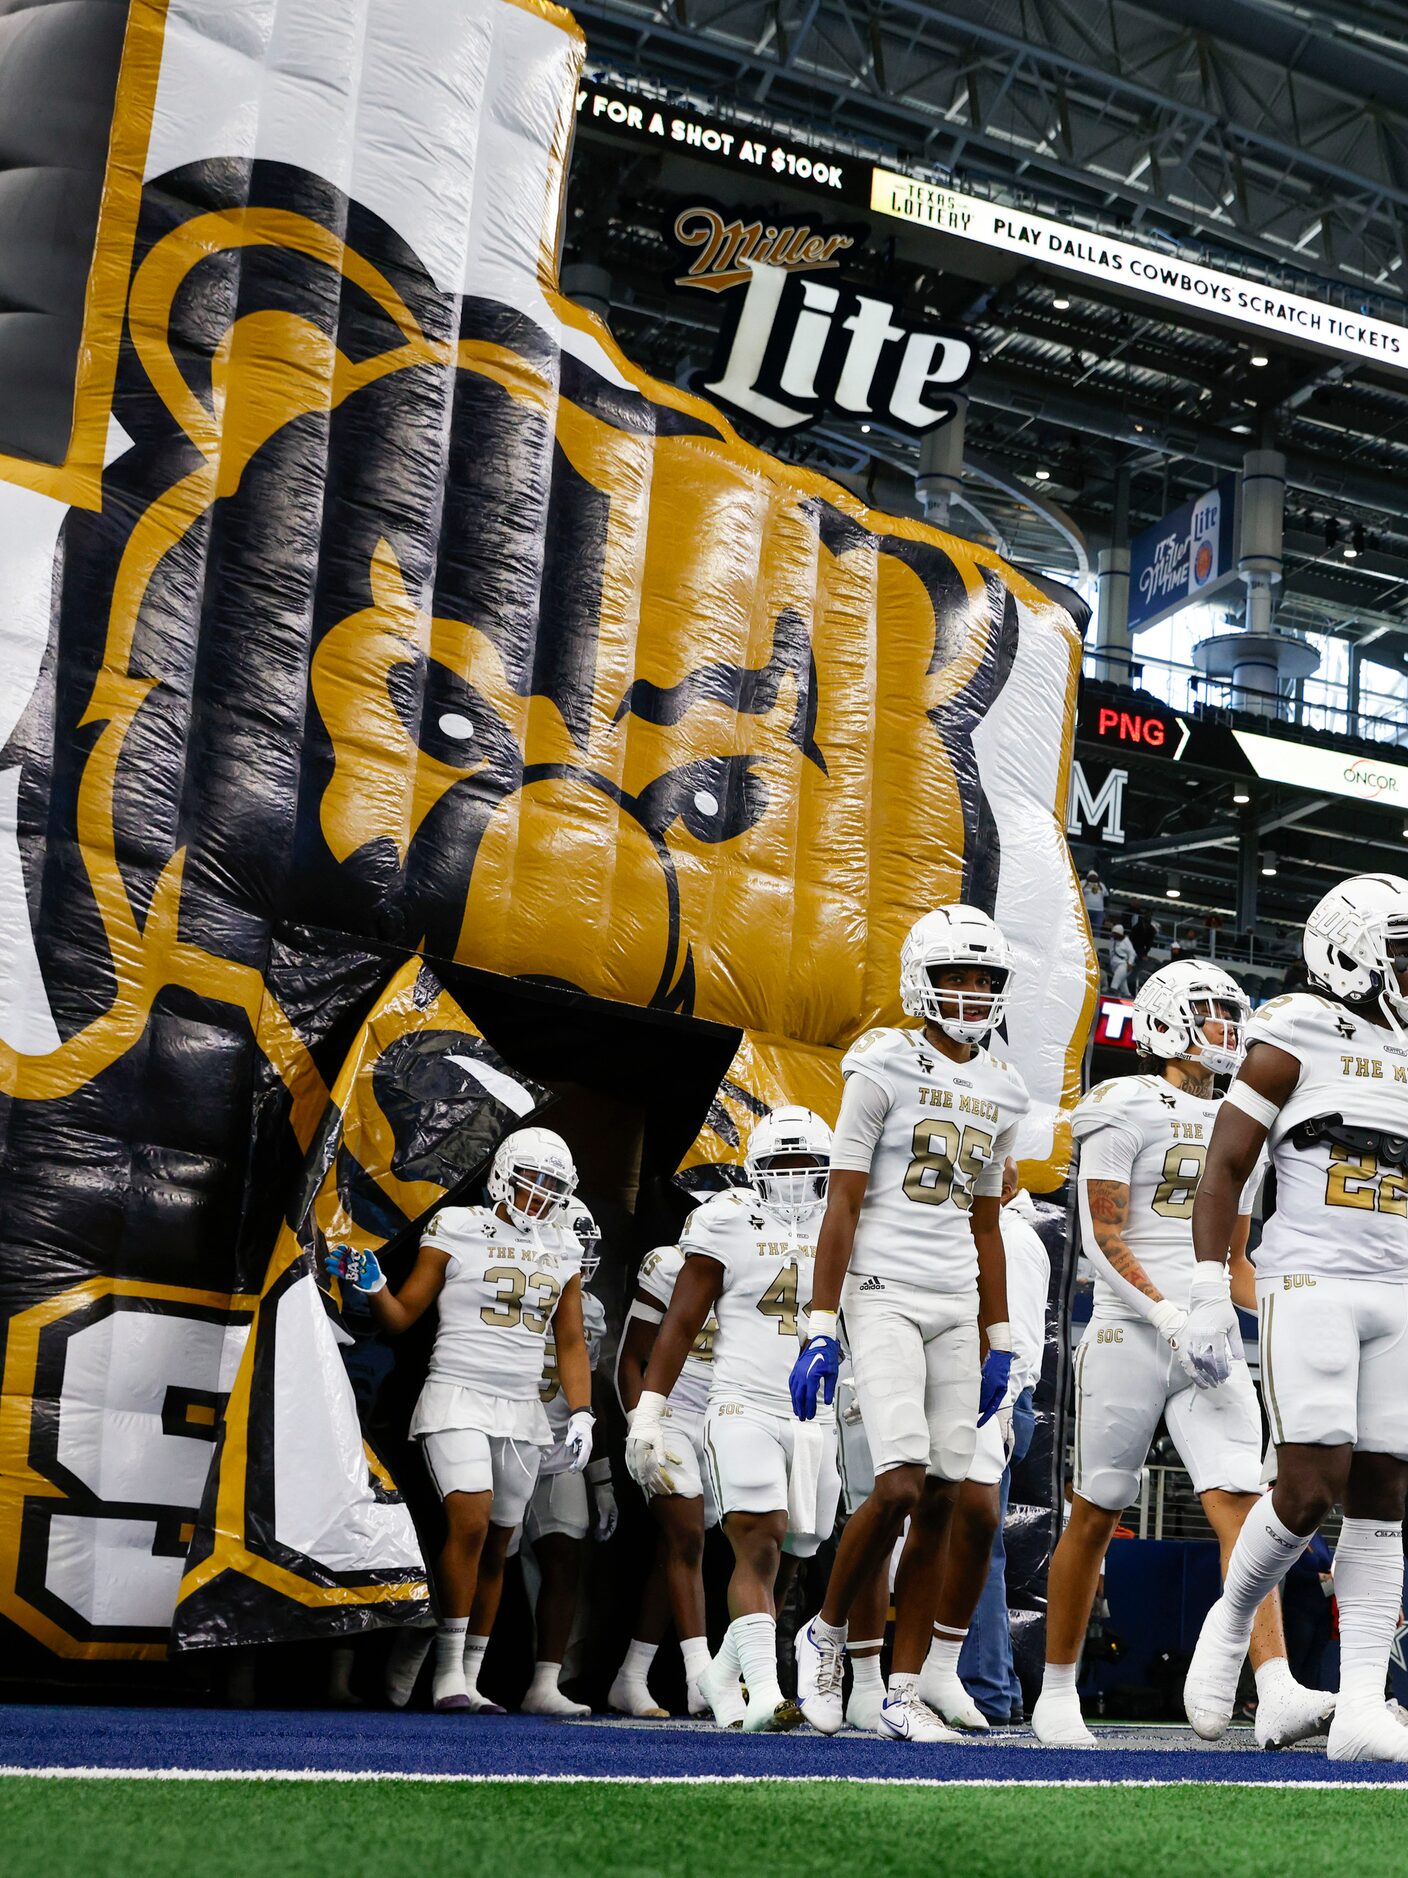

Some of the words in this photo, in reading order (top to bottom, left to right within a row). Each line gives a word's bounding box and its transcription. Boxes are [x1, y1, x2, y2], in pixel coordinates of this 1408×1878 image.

[593, 95, 643, 129] FOR
[649, 113, 664, 136] A
[671, 119, 734, 155] SHOT
[739, 140, 767, 165] AT
[771, 147, 843, 189] $100K
[892, 191, 971, 231] LOTTERY
[908, 184, 955, 209] TEXAS
[674, 206, 854, 280] Miller
[994, 218, 1041, 245] PLAY
[1049, 235, 1122, 269] DALLAS
[1130, 261, 1231, 302] COWBOYS
[1238, 292, 1321, 330] SCRATCH
[1329, 319, 1400, 352] TICKETS
[704, 257, 971, 428] Lite
[1193, 506, 1218, 541] Lite
[1154, 533, 1177, 564] IT'S
[1139, 537, 1192, 605] Miller
[1162, 563, 1189, 595] TIME
[1098, 707, 1165, 746] PNG
[1343, 768, 1398, 792] ONCOR
[1067, 759, 1129, 844] M
[1340, 1056, 1383, 1078] THE
[919, 1087, 953, 1107] THE
[959, 1094, 998, 1124] MECCA
[1170, 1122, 1203, 1140] THE
[902, 1119, 994, 1210] 85
[1151, 1143, 1208, 1219] 8
[487, 1246, 515, 1259] THE
[757, 1243, 788, 1256] THE
[480, 1266, 560, 1335] 33
[1283, 1274, 1317, 1291] SOC
[1097, 1329, 1123, 1343] SOC
[719, 1404, 744, 1416] SOC
